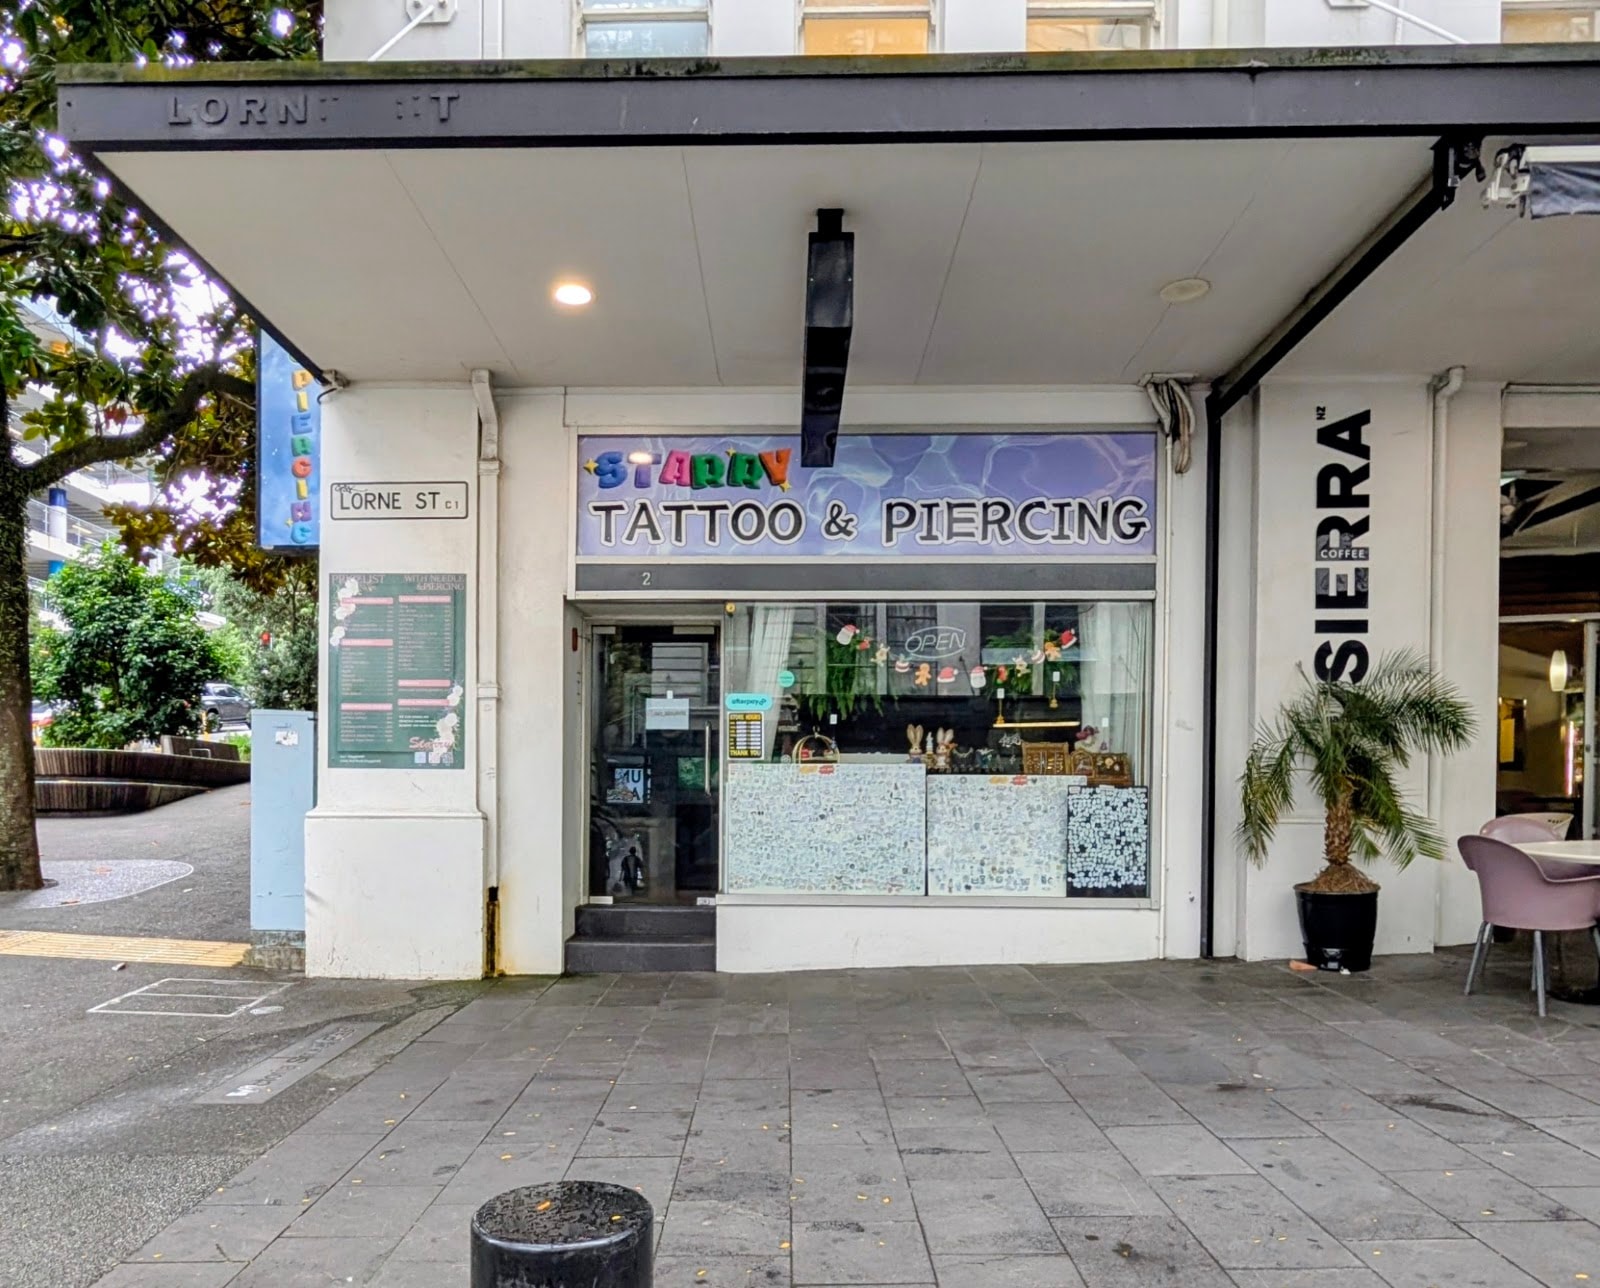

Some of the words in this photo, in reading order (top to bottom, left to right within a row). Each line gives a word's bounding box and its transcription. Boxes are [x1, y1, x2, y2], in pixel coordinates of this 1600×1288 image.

[167, 94, 341, 126] LORN
[593, 447, 792, 490] STARRY
[340, 491, 402, 511] LORNE
[415, 491, 441, 511] ST
[590, 499, 805, 545] TATTOO
[822, 501, 857, 541] &
[884, 498, 1149, 545] PIERCING
[1314, 408, 1371, 684] SIERRA
[1320, 549, 1366, 559] COFFEE
[641, 571, 652, 586] 2
[904, 632, 967, 653] OPEN
